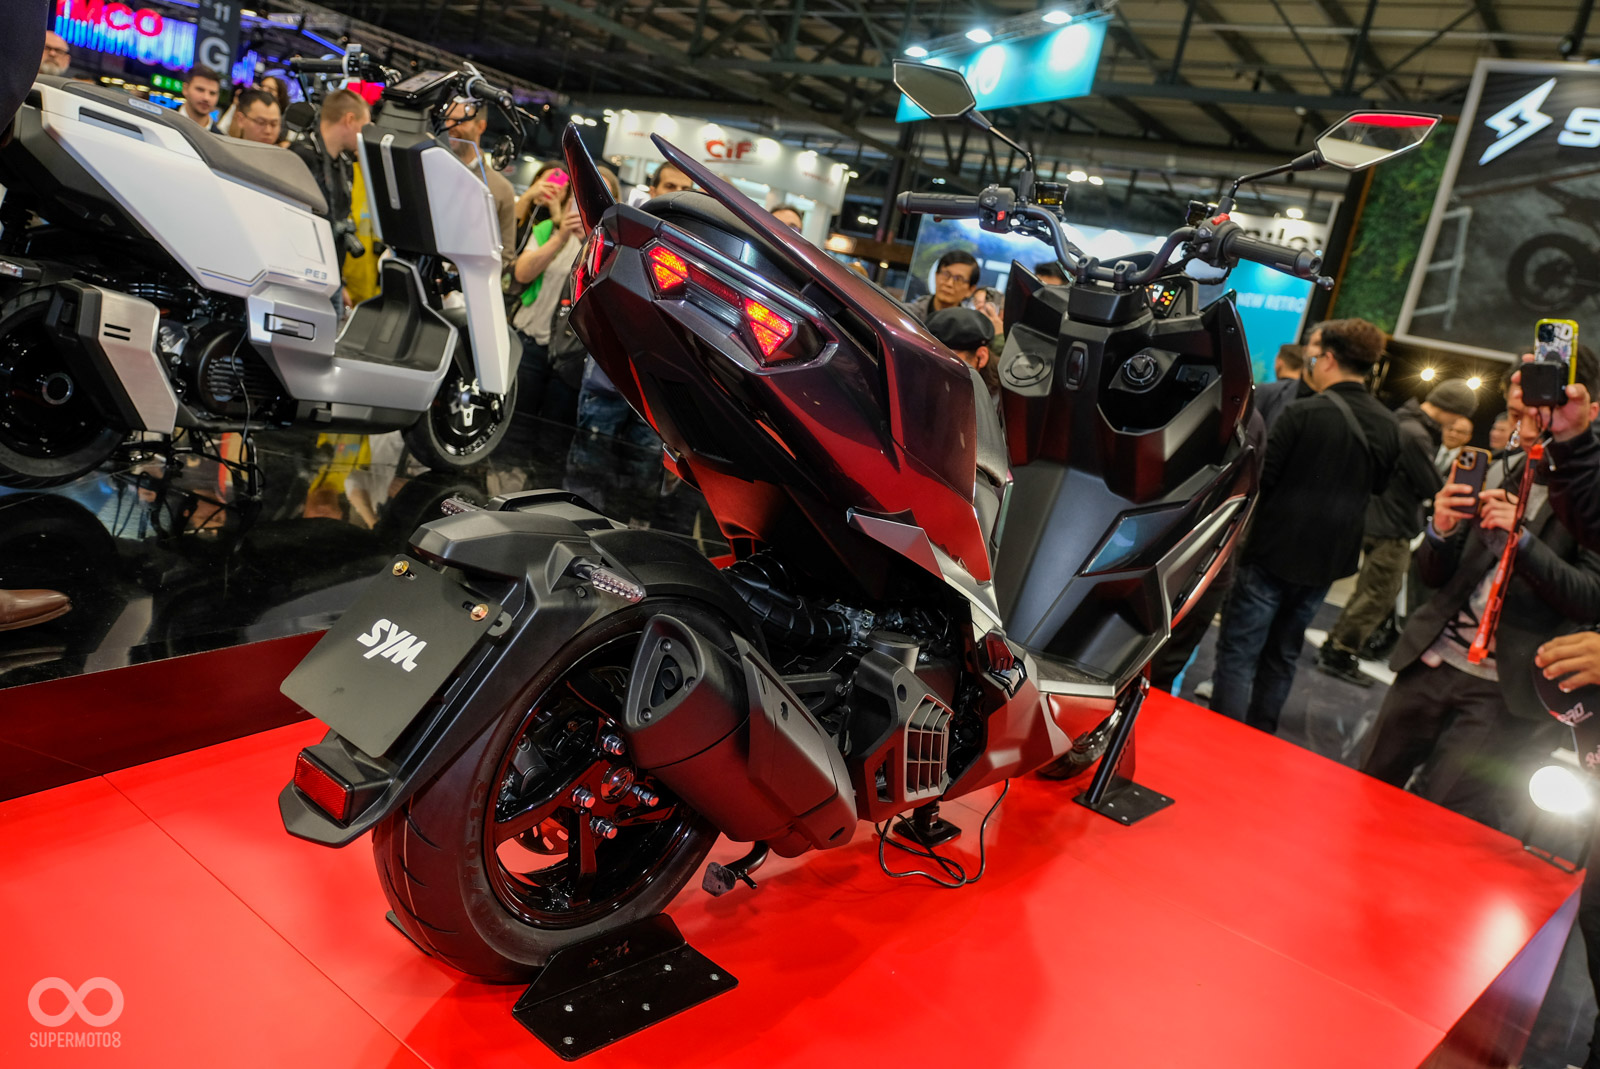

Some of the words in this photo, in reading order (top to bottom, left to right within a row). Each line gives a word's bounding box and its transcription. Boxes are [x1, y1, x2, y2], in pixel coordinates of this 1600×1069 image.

[199, 36, 231, 75] G
[304, 268, 327, 280] PE3
[356, 618, 428, 673] SYM
